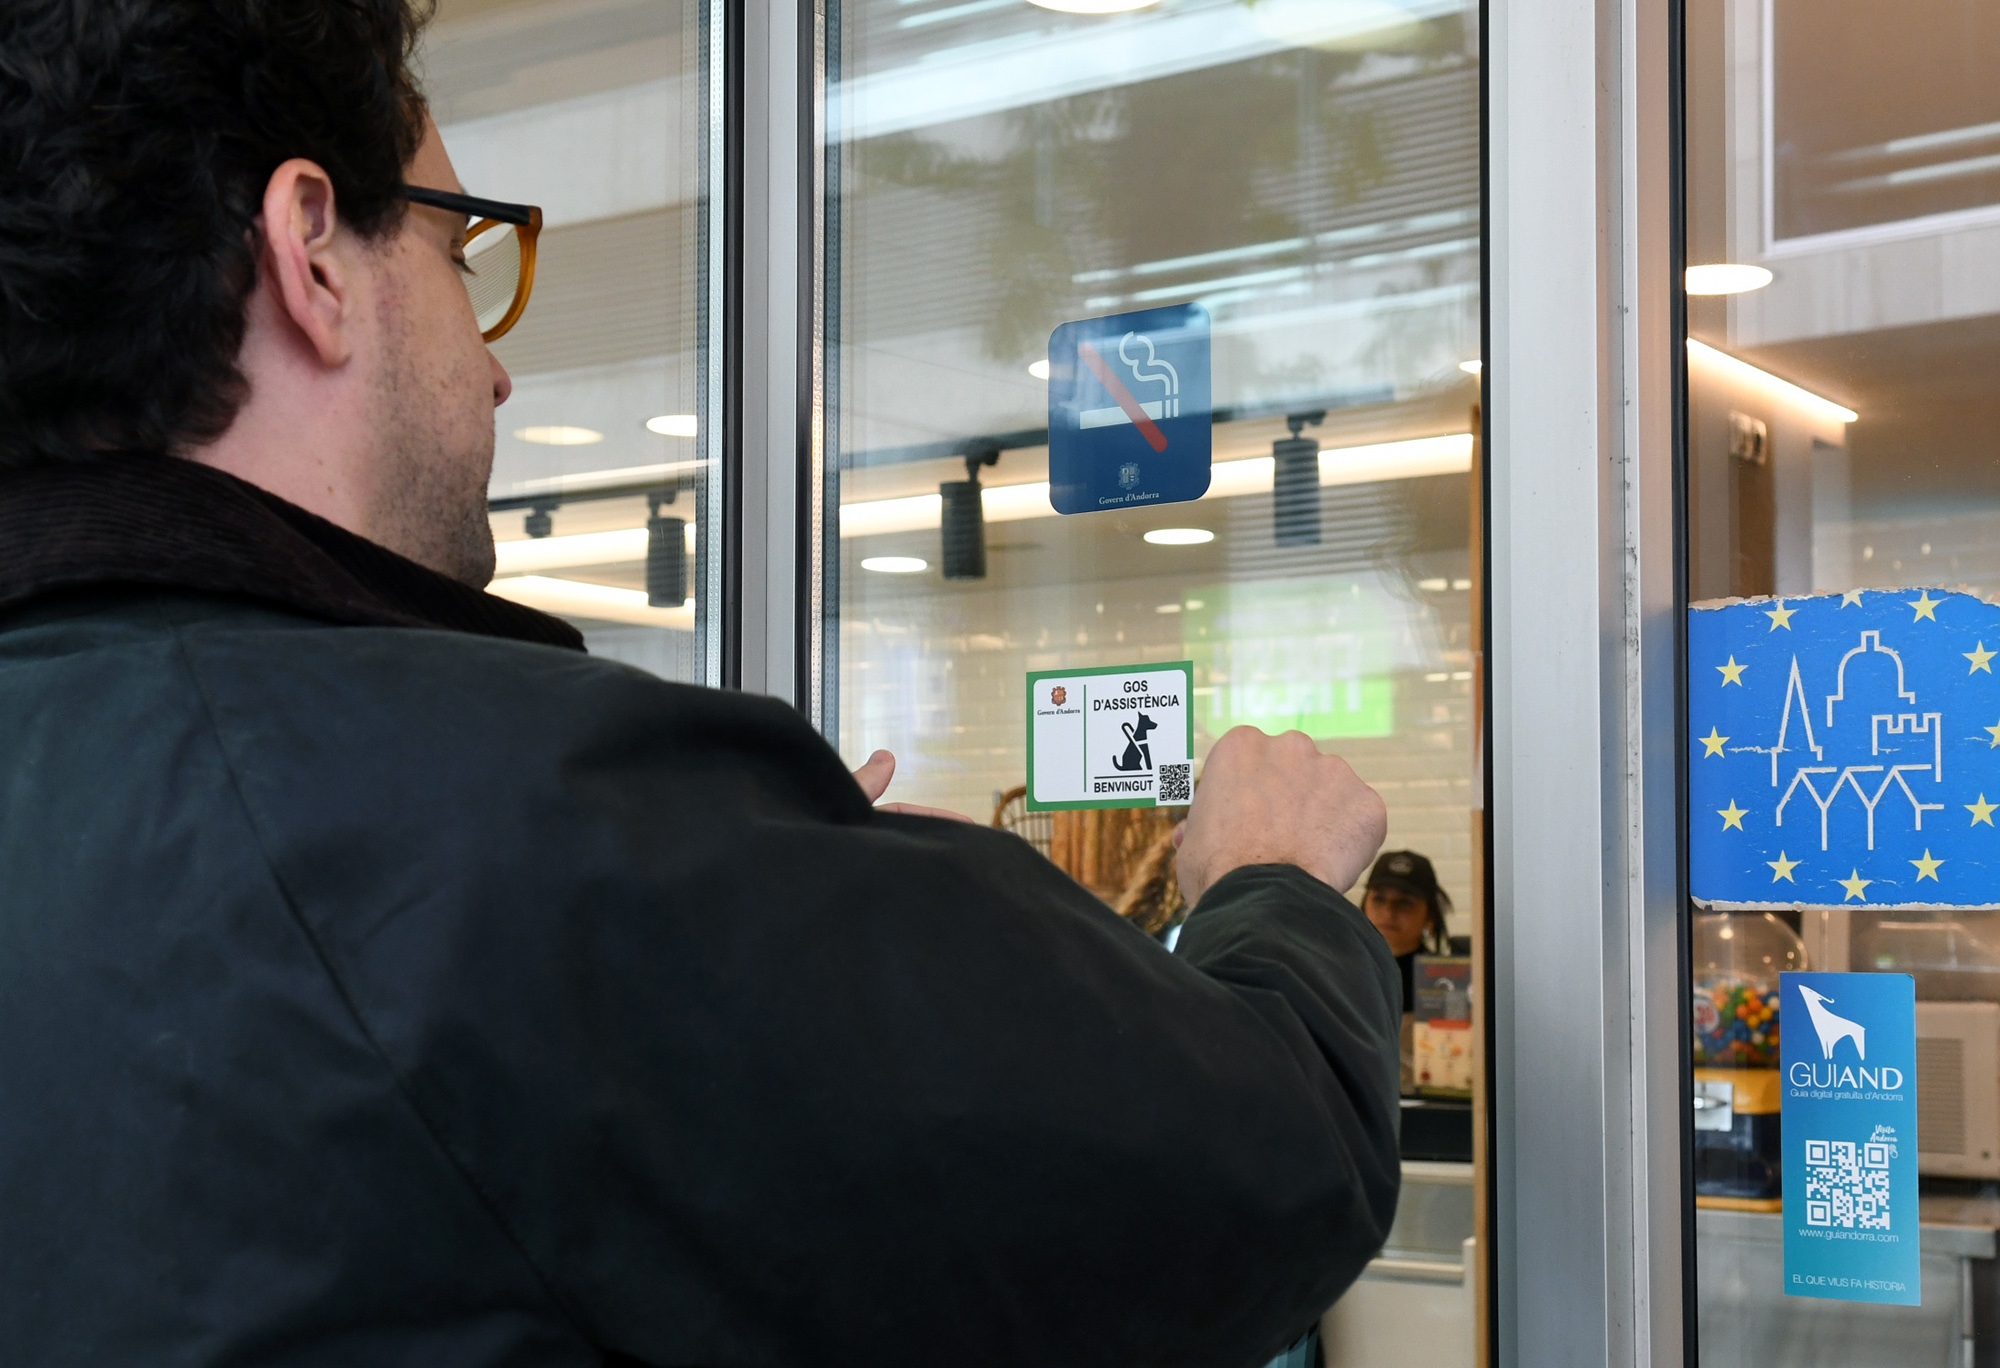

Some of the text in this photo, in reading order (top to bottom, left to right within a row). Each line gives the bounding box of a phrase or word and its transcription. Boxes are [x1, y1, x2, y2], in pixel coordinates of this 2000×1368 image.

[1099, 492, 1159, 504] Govern d'Andorra
[1123, 680, 1148, 693] GOS
[1093, 694, 1179, 711] D'ASSISTÈNCIA
[1094, 780, 1153, 793] BENVINGUT
[1790, 1062, 1903, 1090] GUIAND
[1790, 1088, 1809, 1097] Guia
[1810, 1089, 1832, 1100] digital
[1865, 1092, 1903, 1101] d'Andorra
[1875, 1124, 1896, 1134] Visita
[1870, 1132, 1898, 1143] Andorra
[1799, 1229, 1899, 1242] www.guiandorra.com
[1793, 1274, 1906, 1291] EL QUE VIUS FA HISTORIA
